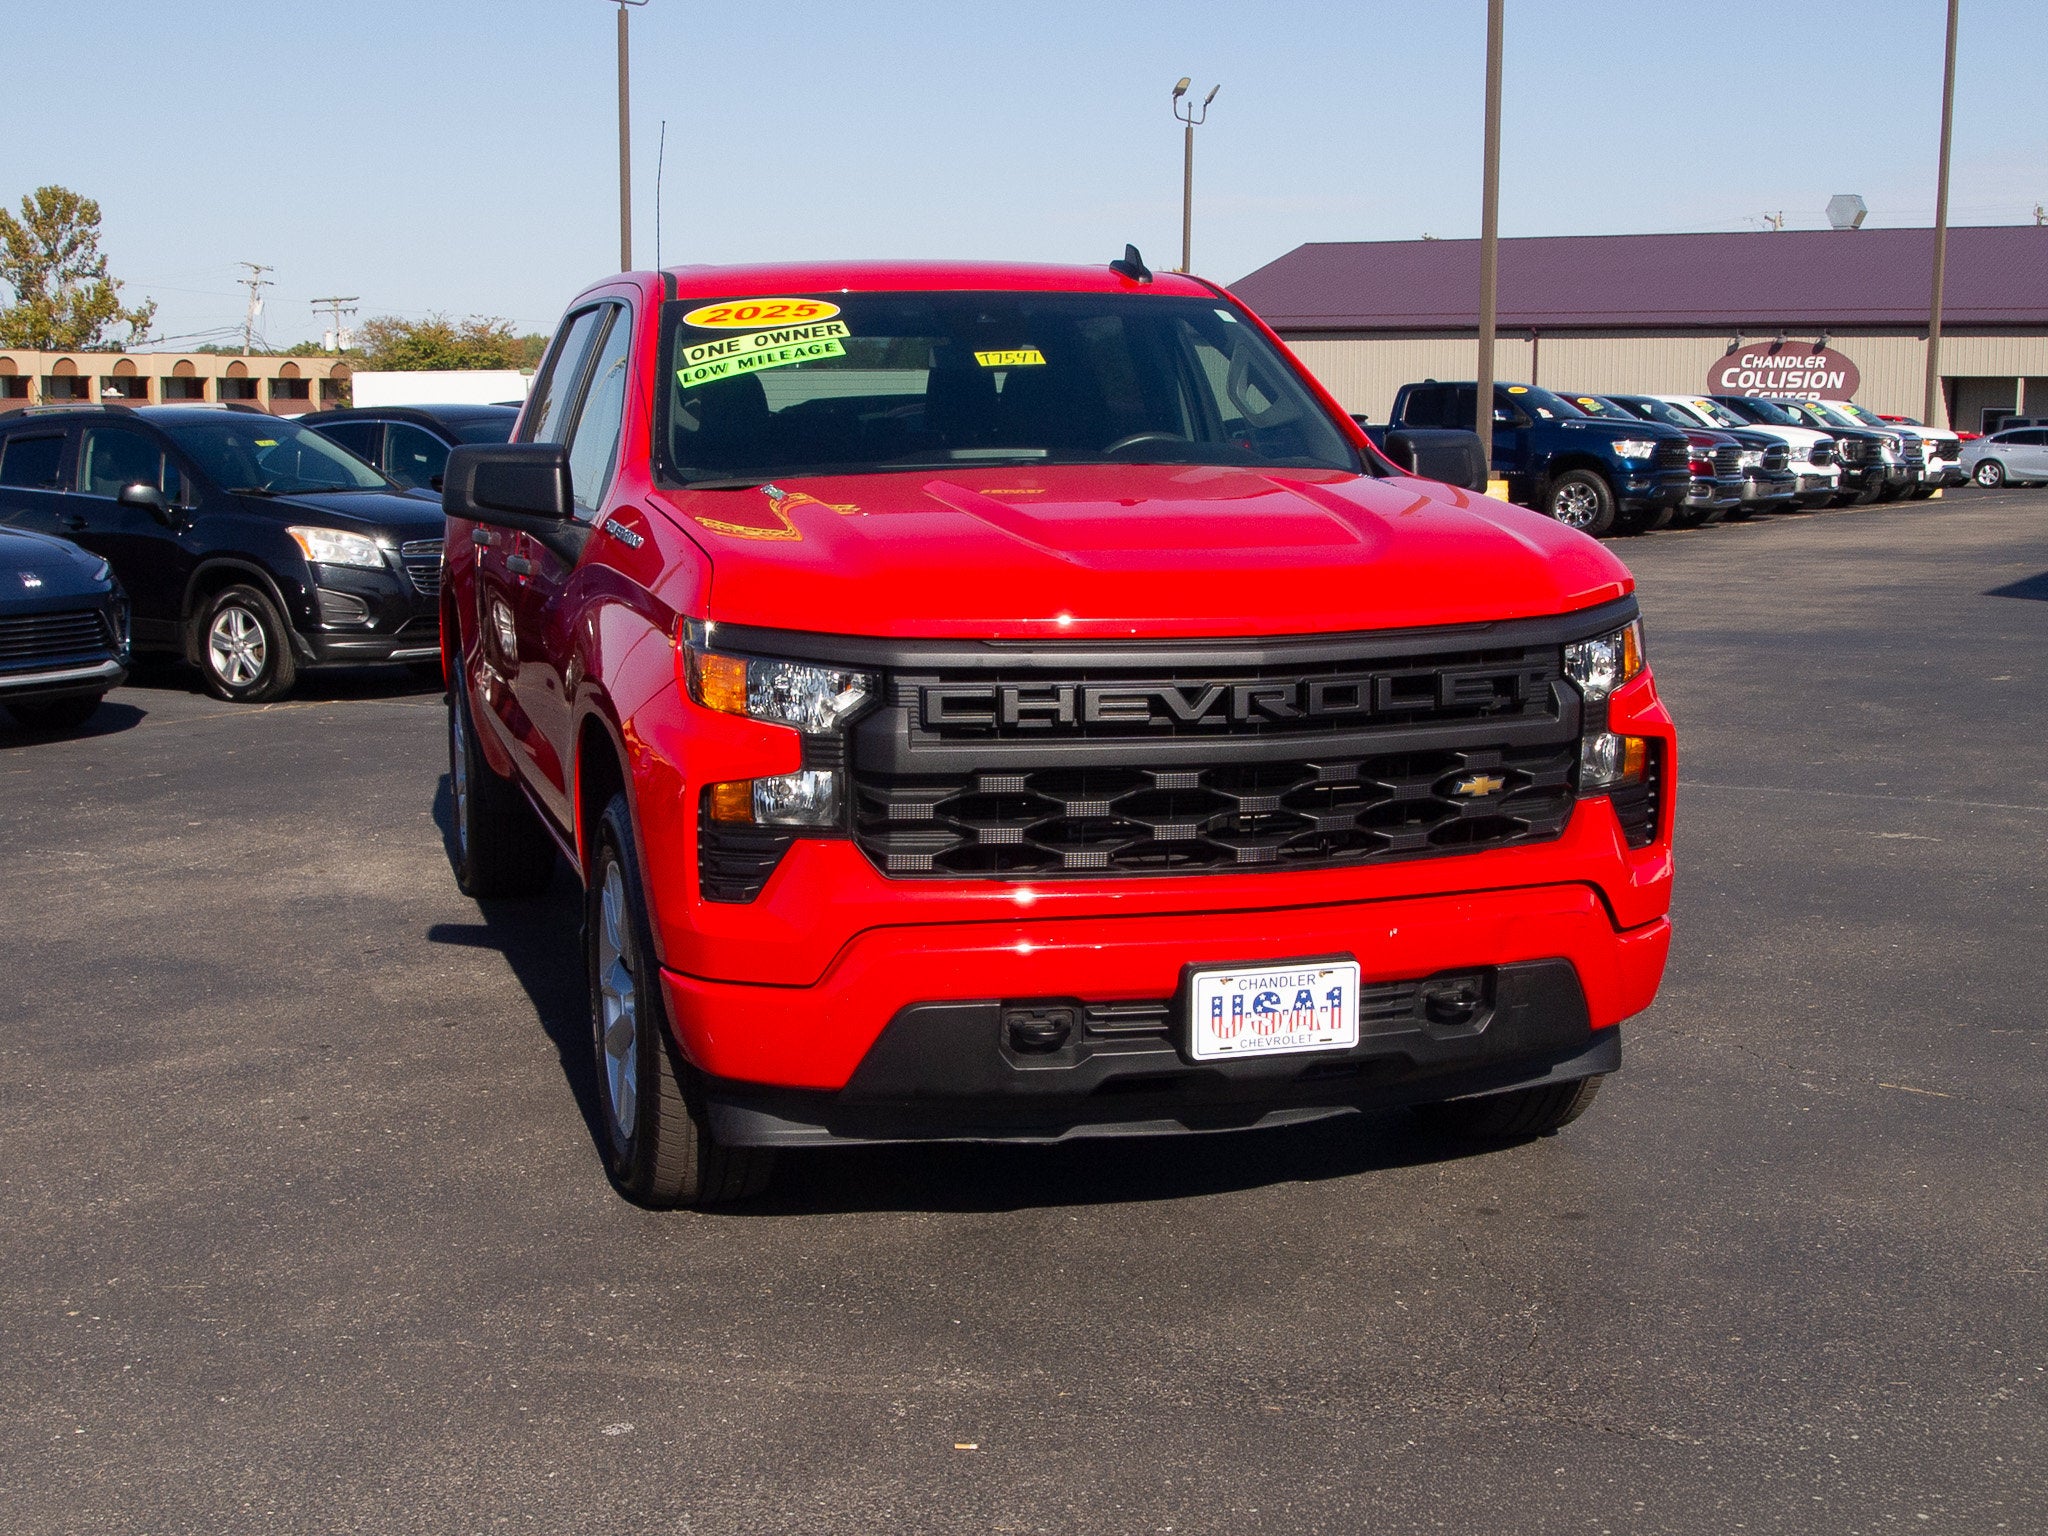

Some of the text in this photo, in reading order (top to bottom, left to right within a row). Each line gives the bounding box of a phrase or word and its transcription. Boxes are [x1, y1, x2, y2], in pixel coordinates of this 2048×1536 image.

[703, 304, 820, 324] 2025
[690, 323, 844, 361] ONE OWNER
[683, 342, 838, 383] LOW MILEAGE
[1741, 354, 1827, 369] CHANDLER
[1721, 367, 1846, 389] COLLISION
[922, 665, 1548, 727] CHEVROLET
[1238, 974, 1316, 991] CHANDLER
[1240, 1034, 1313, 1049] CHEVROLET
